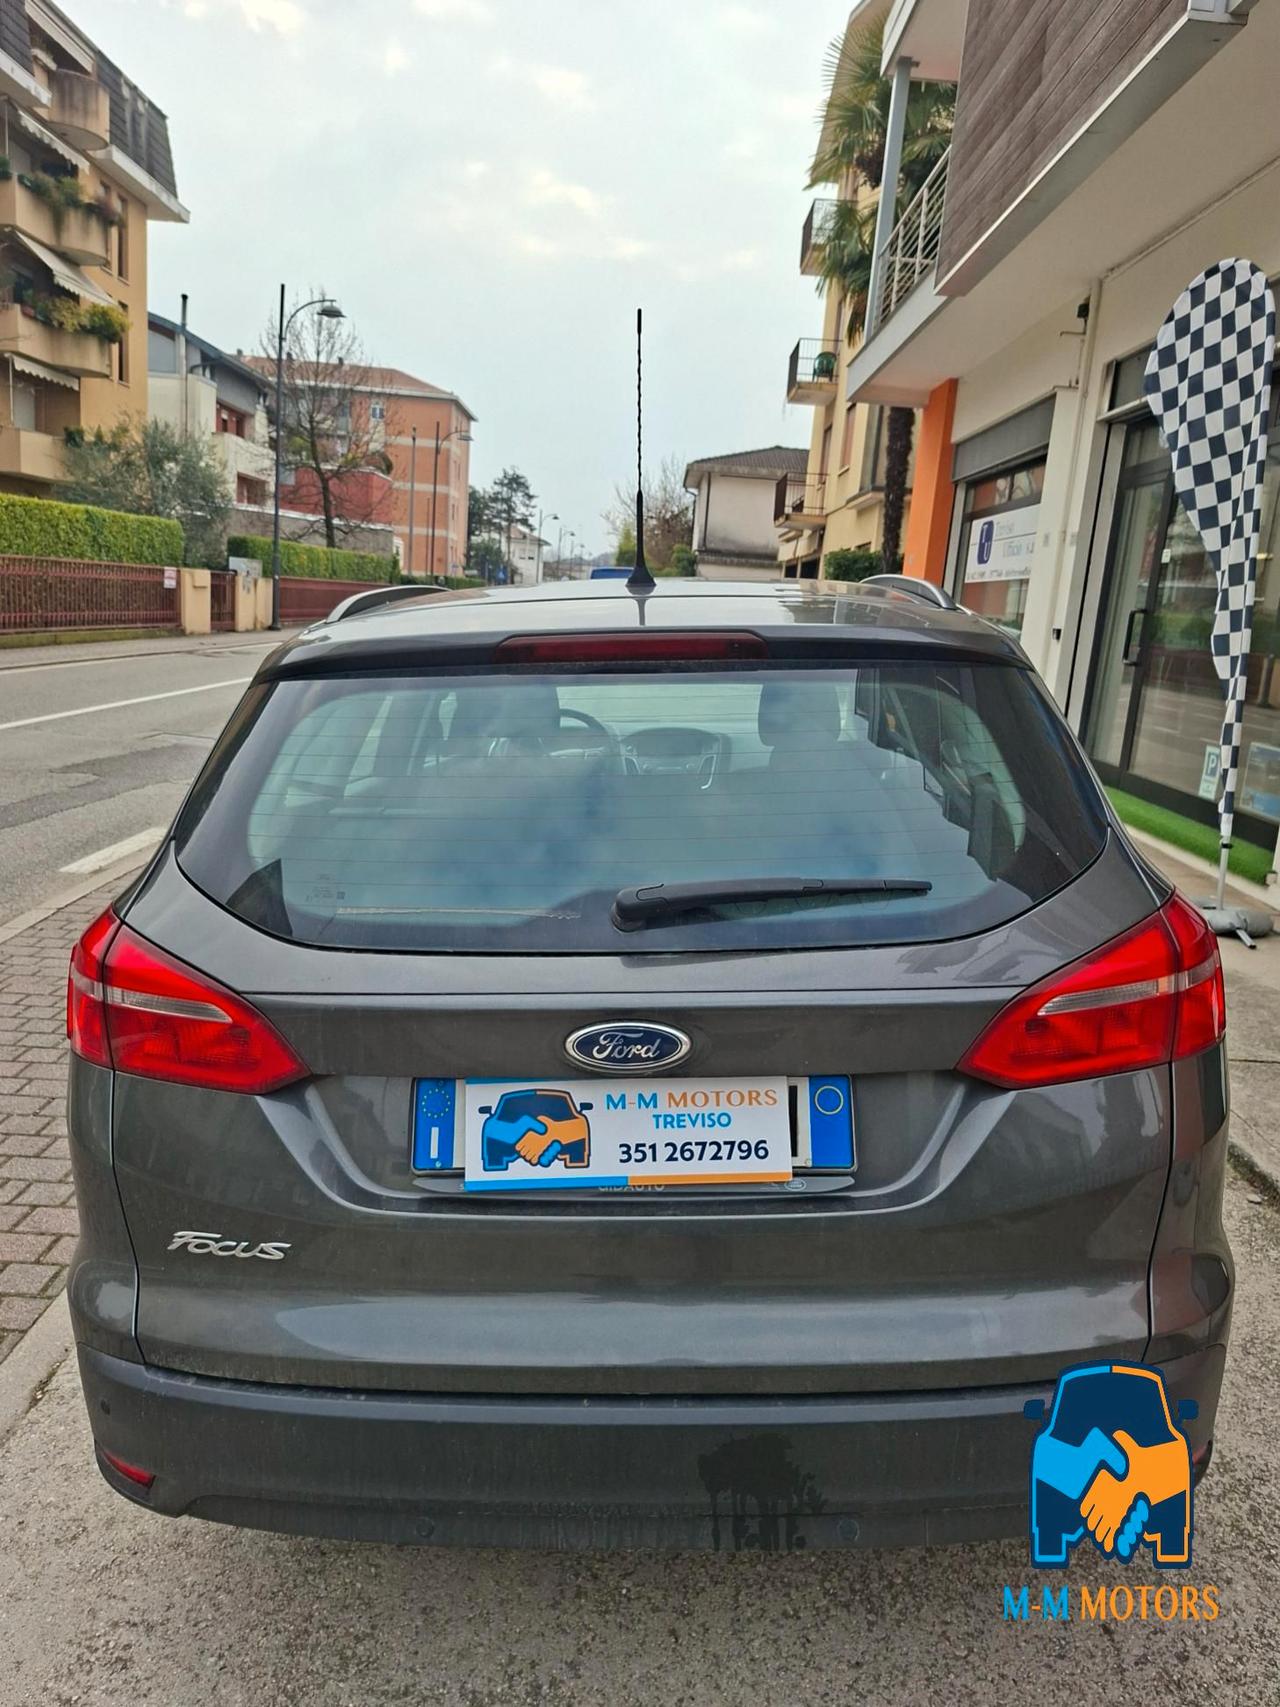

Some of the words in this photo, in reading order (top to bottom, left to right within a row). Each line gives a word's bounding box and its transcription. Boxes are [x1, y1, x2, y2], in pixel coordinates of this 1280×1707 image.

[592, 1031, 661, 1059] Ford
[606, 1092, 658, 1111] M-M
[667, 1089, 778, 1109] MOTORS
[652, 1112, 732, 1129] TREVISO
[618, 1142, 657, 1163] 351
[665, 1139, 769, 1162] 2672796
